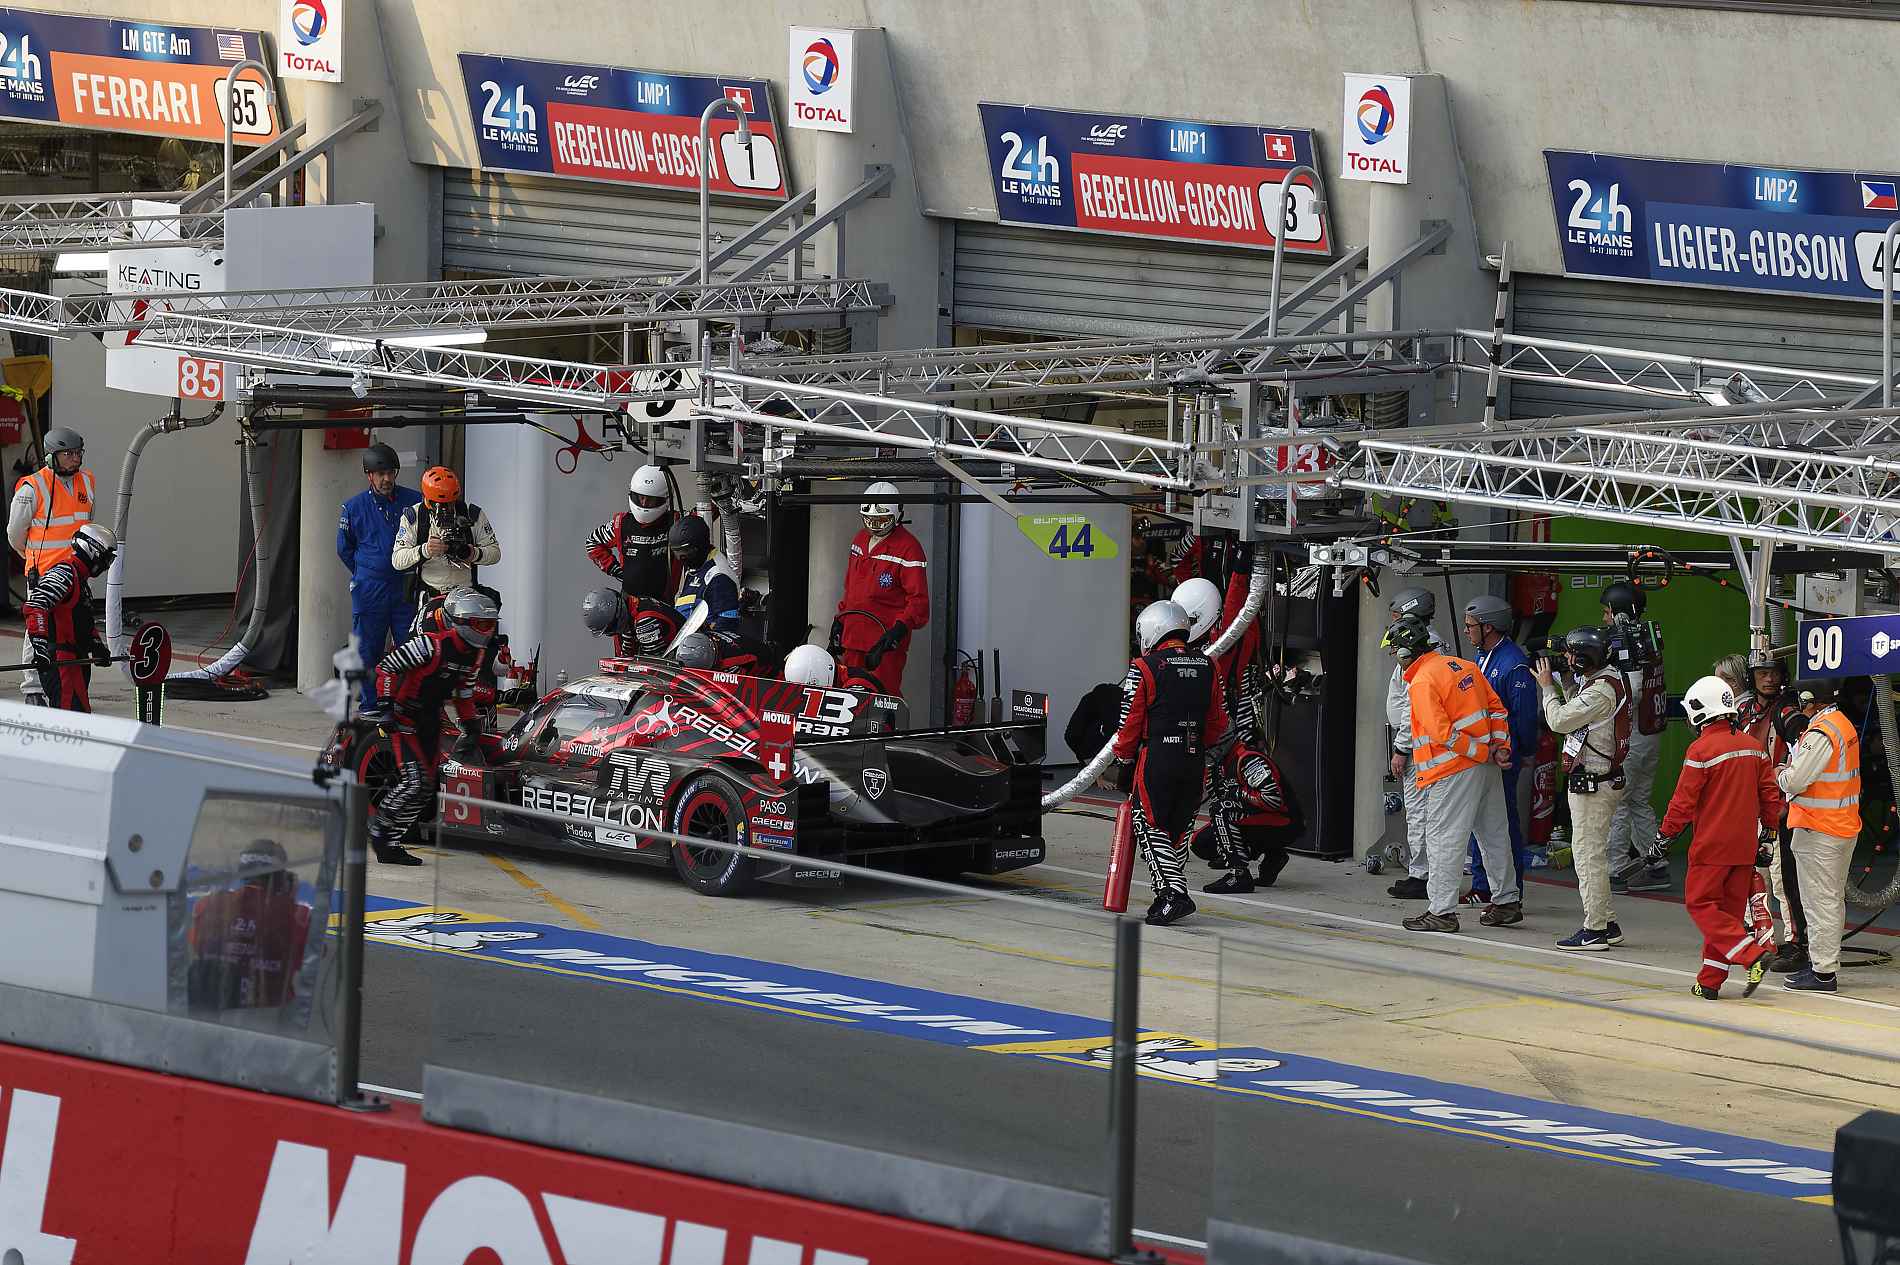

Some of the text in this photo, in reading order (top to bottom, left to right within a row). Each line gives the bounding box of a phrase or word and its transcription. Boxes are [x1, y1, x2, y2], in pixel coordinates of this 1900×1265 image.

[122, 28, 191, 57] LM GTE Am
[284, 52, 335, 74] TOTAL
[8, 79, 44, 94] MANS
[72, 71, 202, 126] FERRARI
[637, 80, 671, 107] LMP1
[231, 87, 257, 127] 85
[480, 80, 536, 131] 24h
[794, 102, 847, 124] TOTAL
[482, 127, 538, 145] LE MANS
[553, 120, 720, 181] REBELLION-GIBSON
[1169, 128, 1206, 154] LMP1
[744, 141, 755, 181] 1
[1000, 131, 1060, 183] 24h
[1347, 152, 1402, 174] TOTAL
[1002, 180, 1061, 198] LE MANS
[1079, 172, 1257, 232] REBELLION-GIBSON
[1567, 179, 1632, 233] 24h
[1755, 176, 1798, 204] LMP2
[1284, 191, 1298, 233] 3
[1568, 229, 1633, 248] LE MANS
[1654, 221, 1849, 282] LIGIER-GIBSON
[118, 264, 201, 290] KEATING
[180, 358, 222, 399] 85
[1049, 523, 1095, 559] 44
[134, 625, 164, 680] 3
[1807, 625, 1843, 671] 90
[1875, 640, 1885, 650] TF
[713, 672, 739, 685] MOTUL
[145, 690, 154, 727] REB
[763, 711, 792, 725] MOTUL
[798, 687, 858, 724] 13
[569, 742, 604, 758] SYNERGIE
[459, 767, 481, 778] TOTAL
[608, 752, 671, 798] TVR
[454, 782, 470, 821] 3
[522, 785, 664, 833] REBELLION
[606, 789, 665, 806] RACING
[760, 799, 787, 815] PASO
[752, 816, 782, 829] ORECA
[501, 947, 1057, 1036] MICHELIN
[1248, 1079, 1833, 1185] MICHELIN
